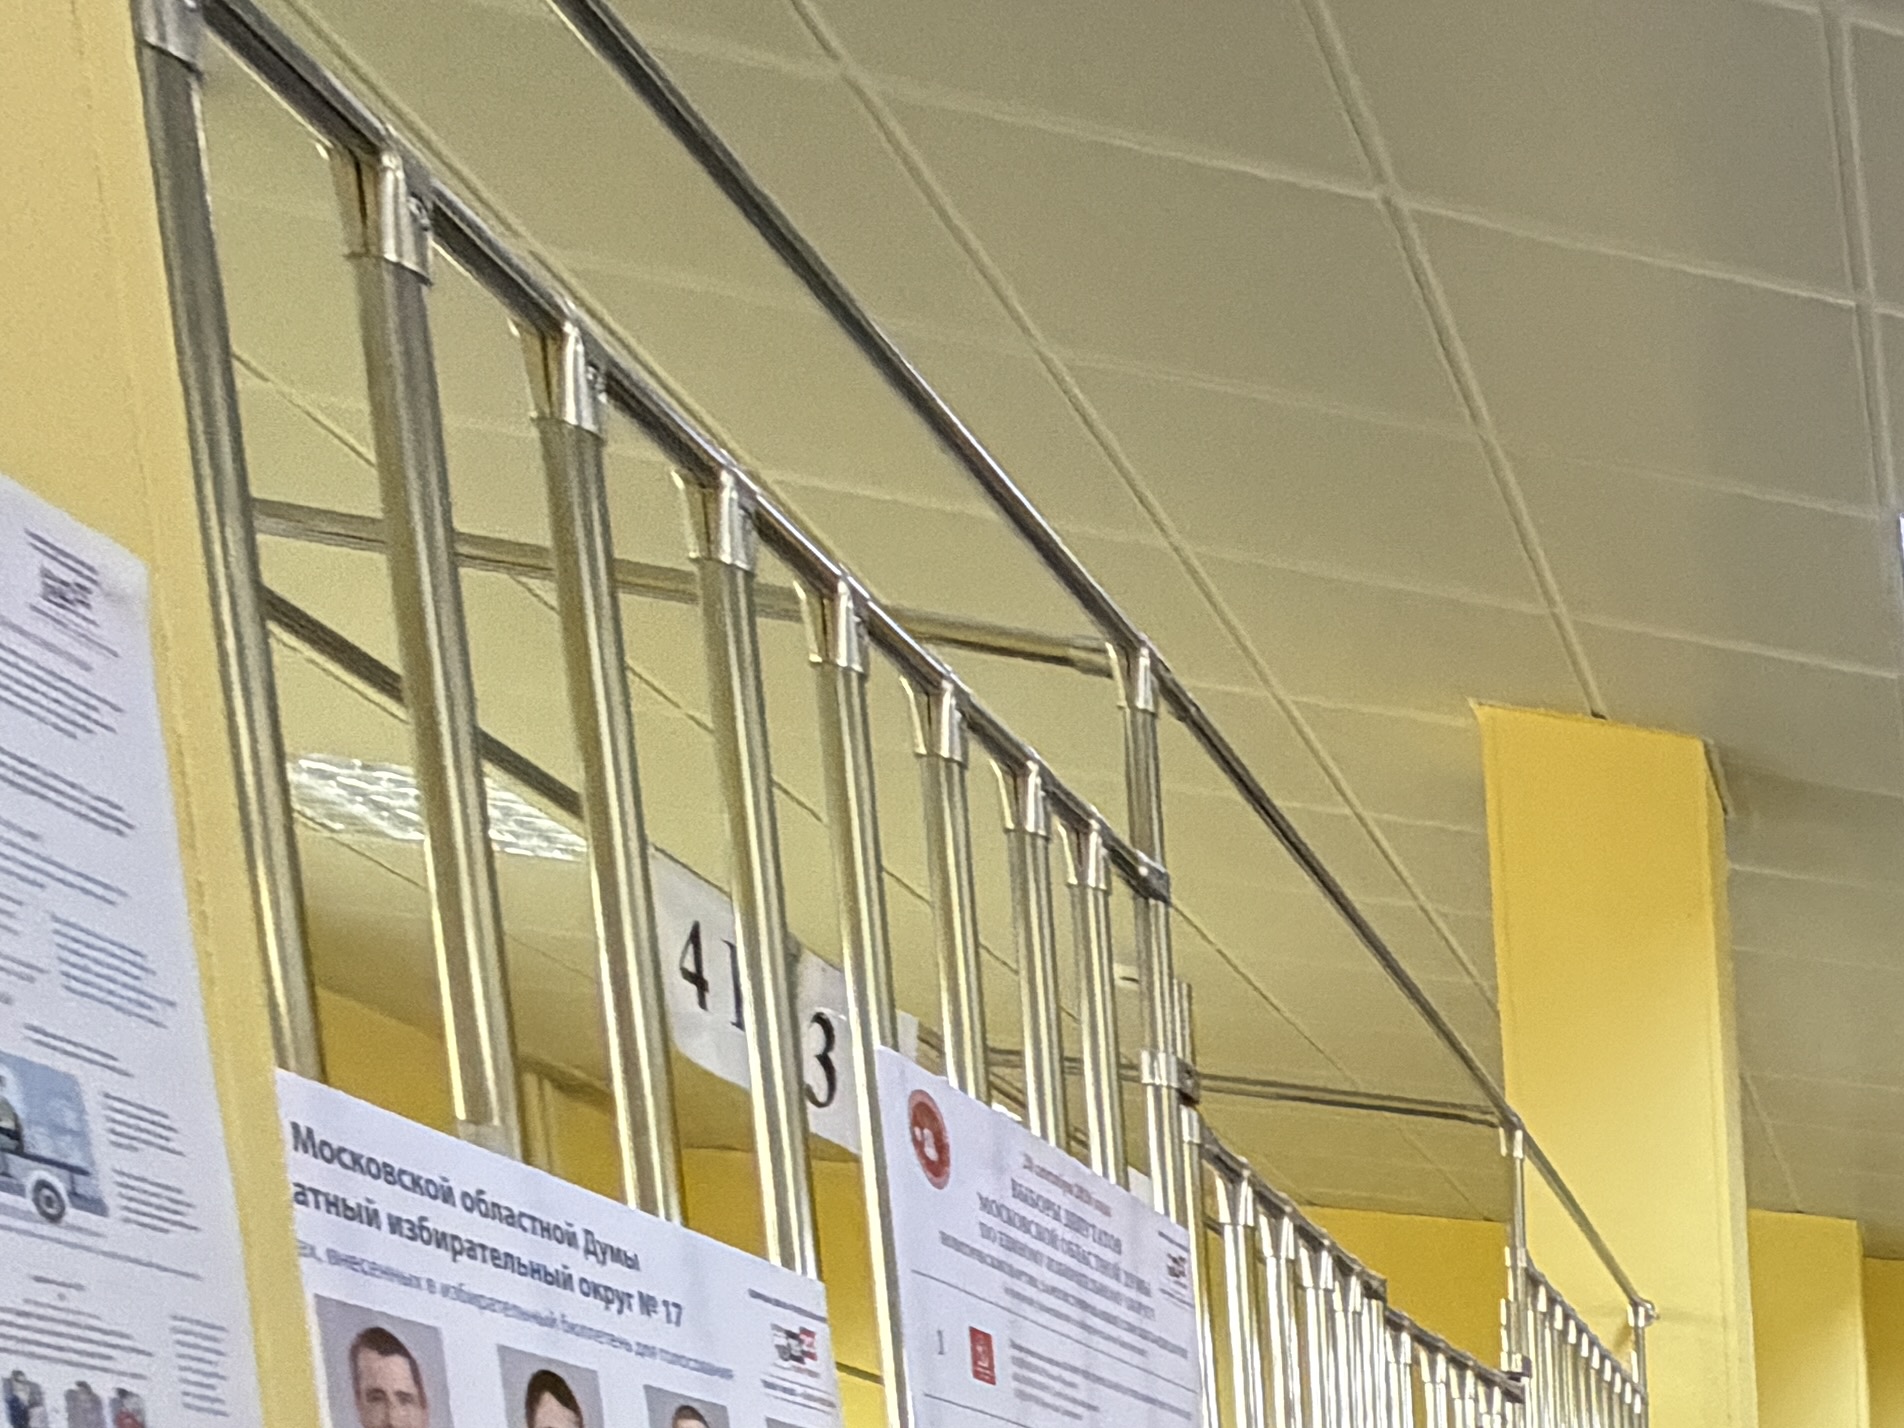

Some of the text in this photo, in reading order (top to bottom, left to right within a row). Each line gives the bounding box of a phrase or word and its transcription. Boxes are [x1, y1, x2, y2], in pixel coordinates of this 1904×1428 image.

[678, 919, 711, 1012] 4
[289, 1120, 641, 1272] Московской областной Думы
[291, 1181, 684, 1328] атный избирательный округ № 17
